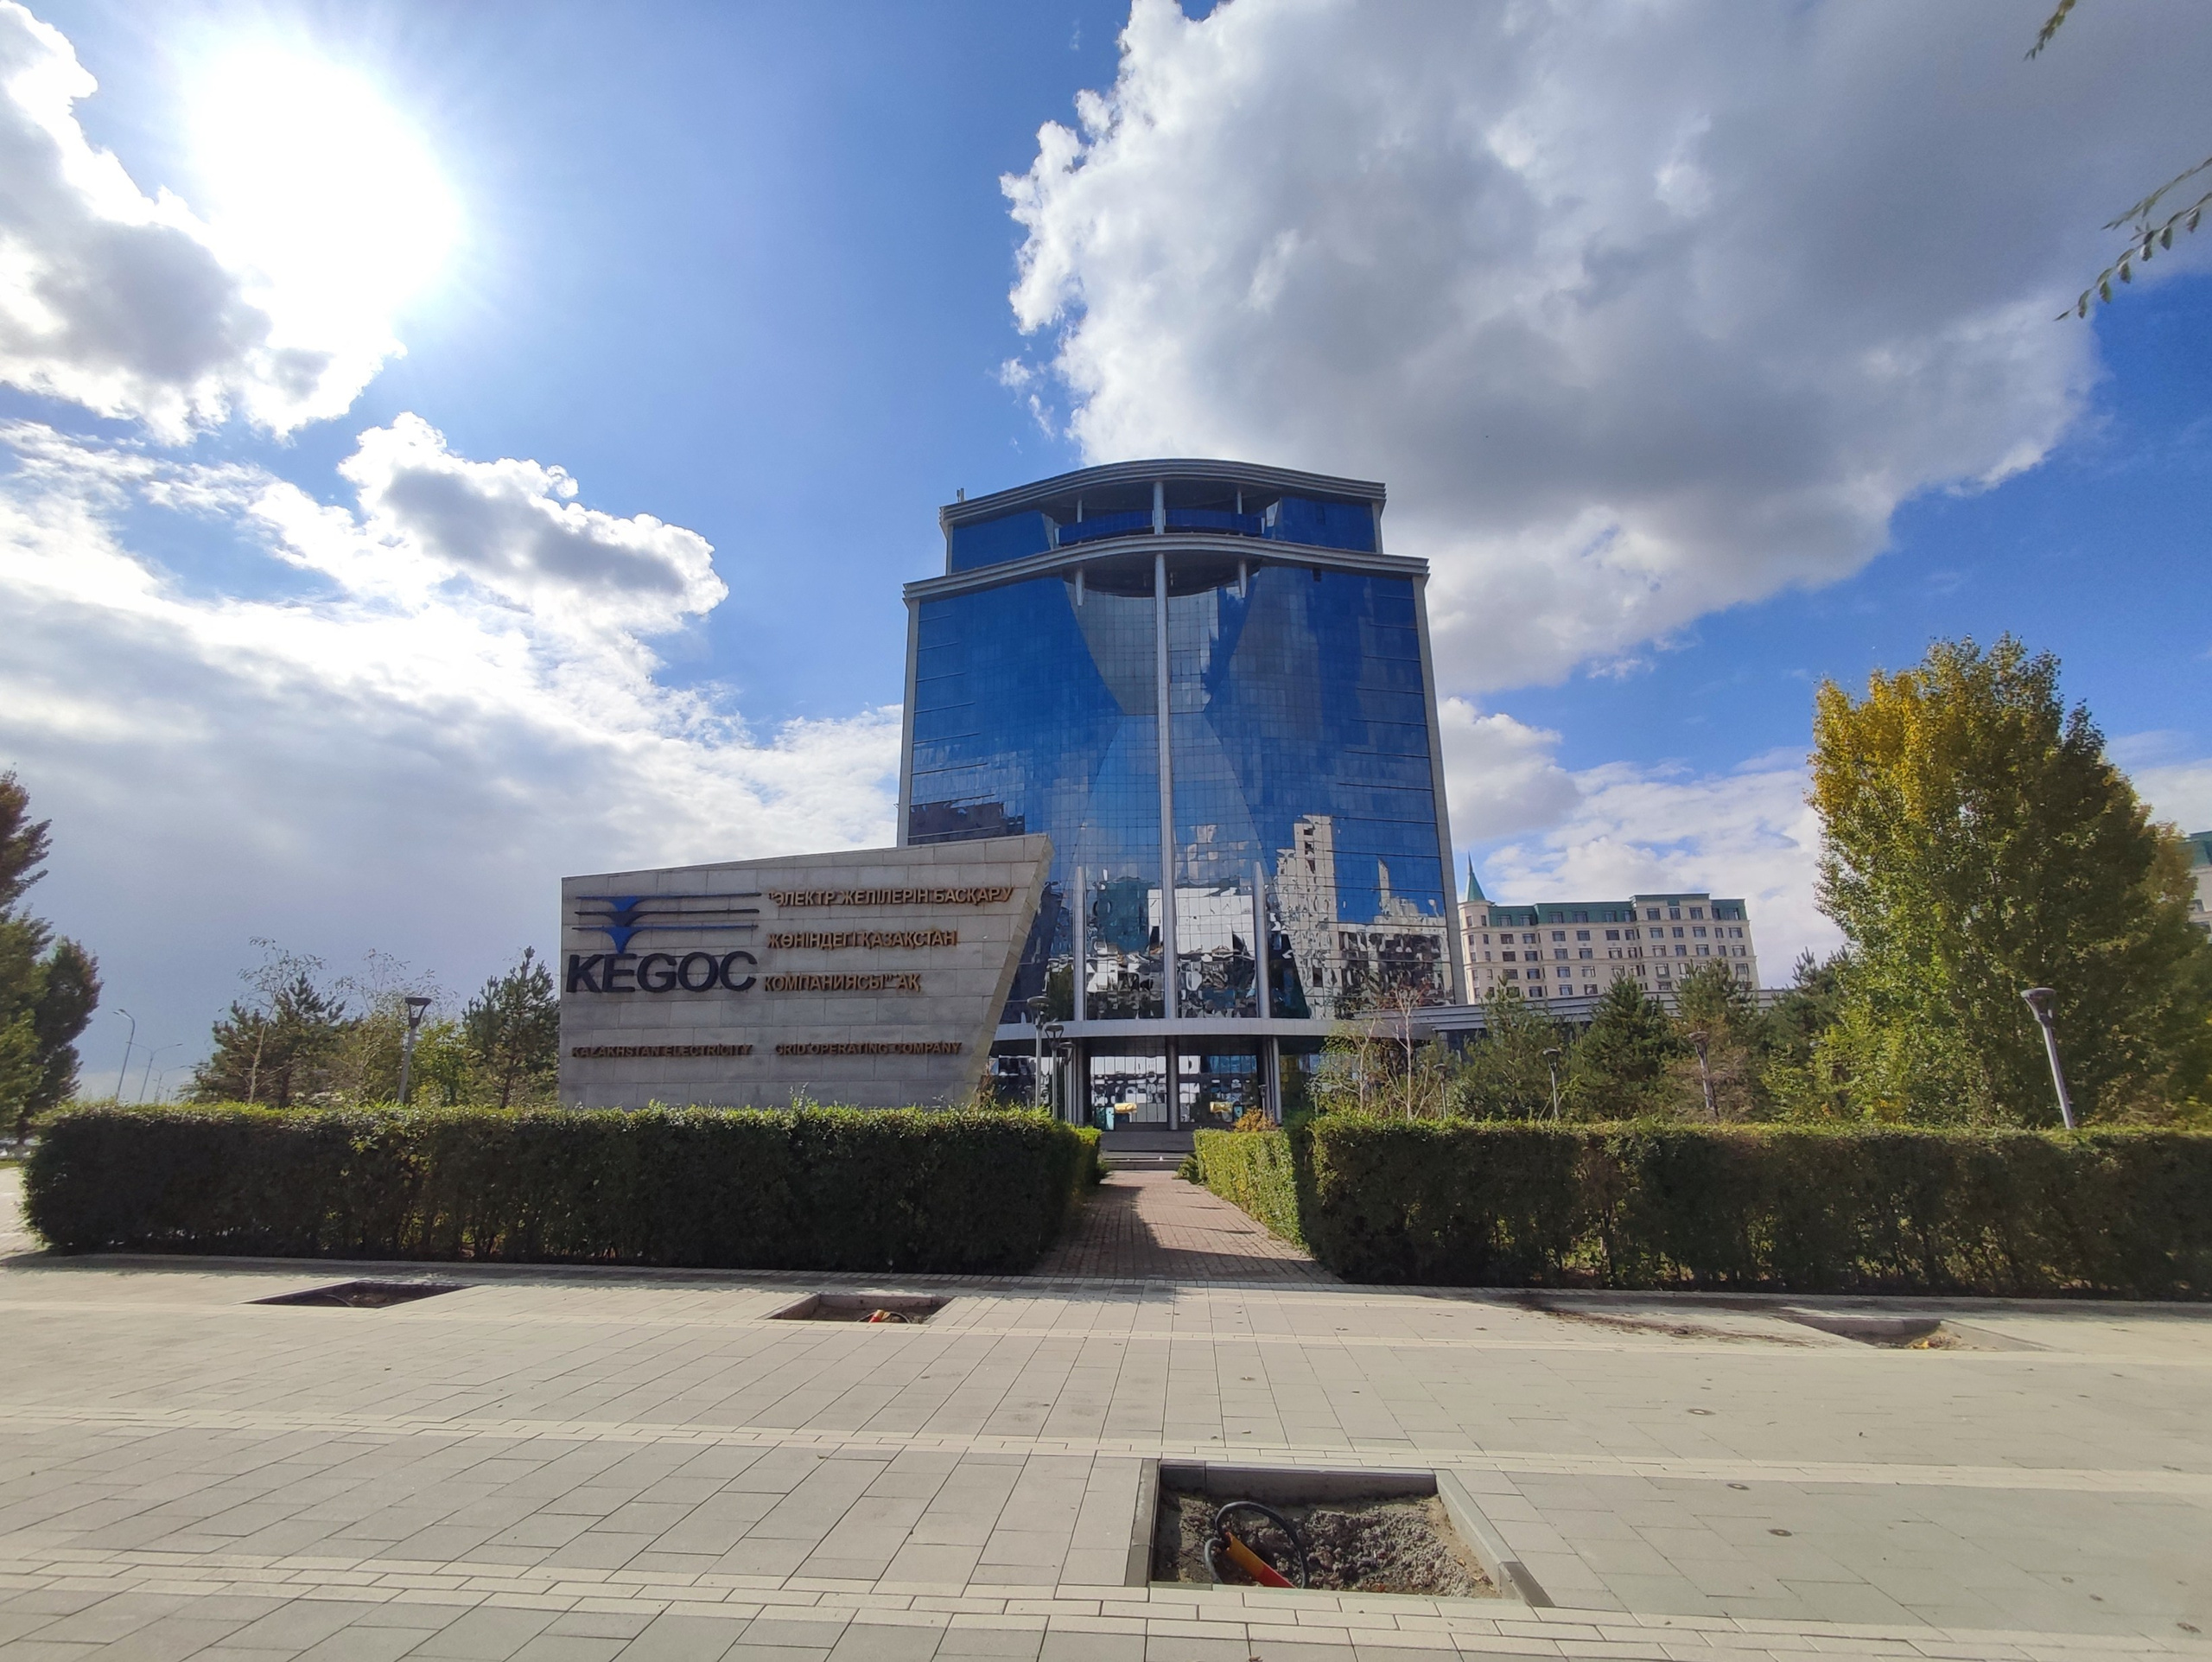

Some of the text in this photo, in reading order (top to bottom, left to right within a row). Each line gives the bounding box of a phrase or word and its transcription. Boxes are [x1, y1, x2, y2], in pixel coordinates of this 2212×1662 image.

[839, 888, 929, 906] ЖЕЛІЛЕРІН
[933, 887, 1013, 906] БАСҚАРУ
[767, 929, 957, 950] ЖӨНІНДЕГІ ҚАЗАҚСТАН
[566, 951, 758, 993] KEGOC
[895, 973, 921, 992] АҚ
[572, 1041, 962, 1058] KAZAKHSTAN ELECTRICITY GRID OPERATING COMPANY
